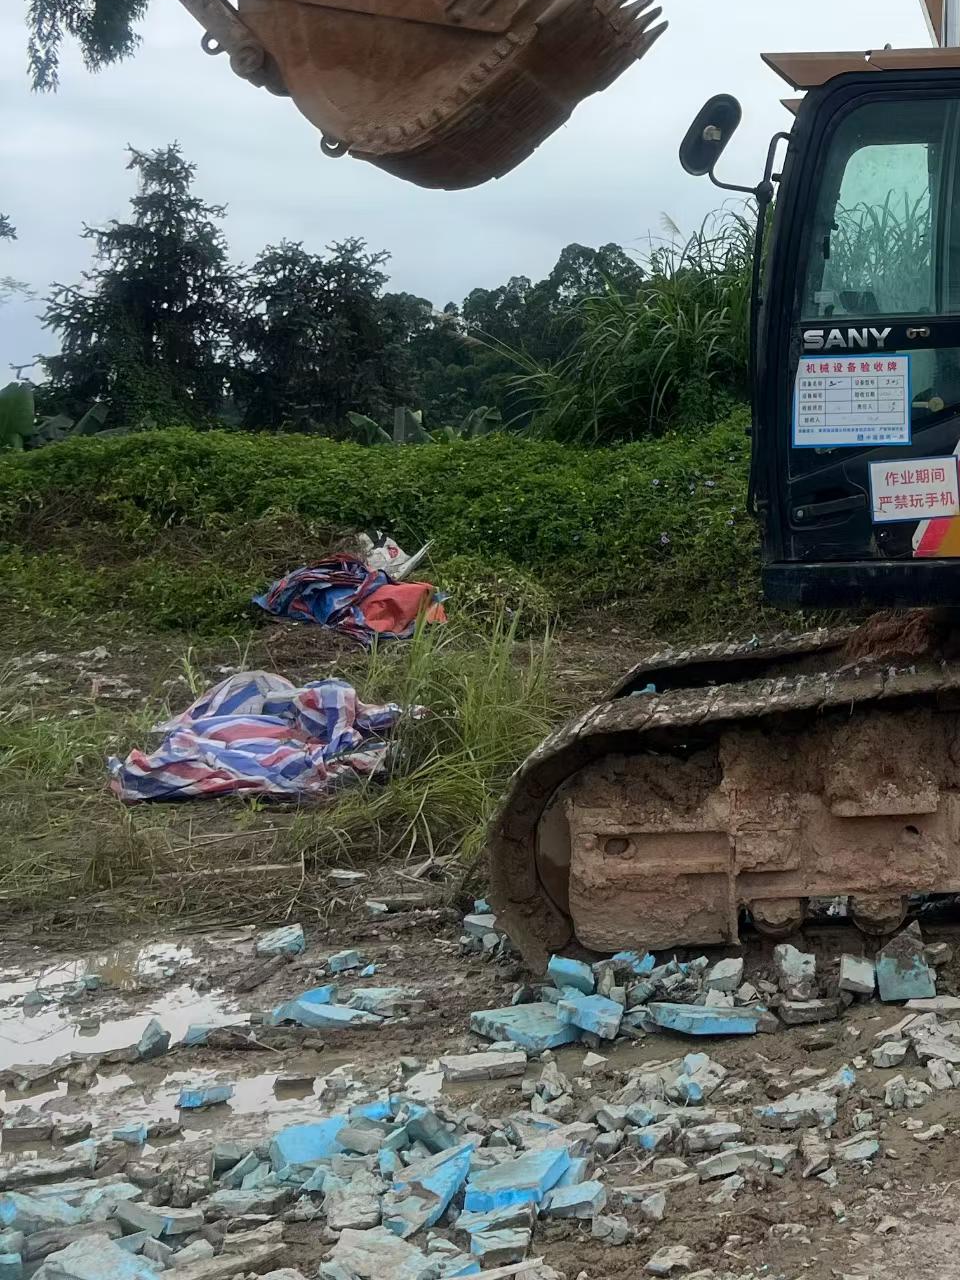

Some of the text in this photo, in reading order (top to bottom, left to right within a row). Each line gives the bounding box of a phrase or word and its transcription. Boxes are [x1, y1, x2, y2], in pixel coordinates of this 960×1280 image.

[803, 327, 892, 349] SANY
[806, 361, 897, 374] 机械设备验收牌
[885, 468, 945, 486] 作业期间
[879, 491, 955, 511] 严禁玩手机
